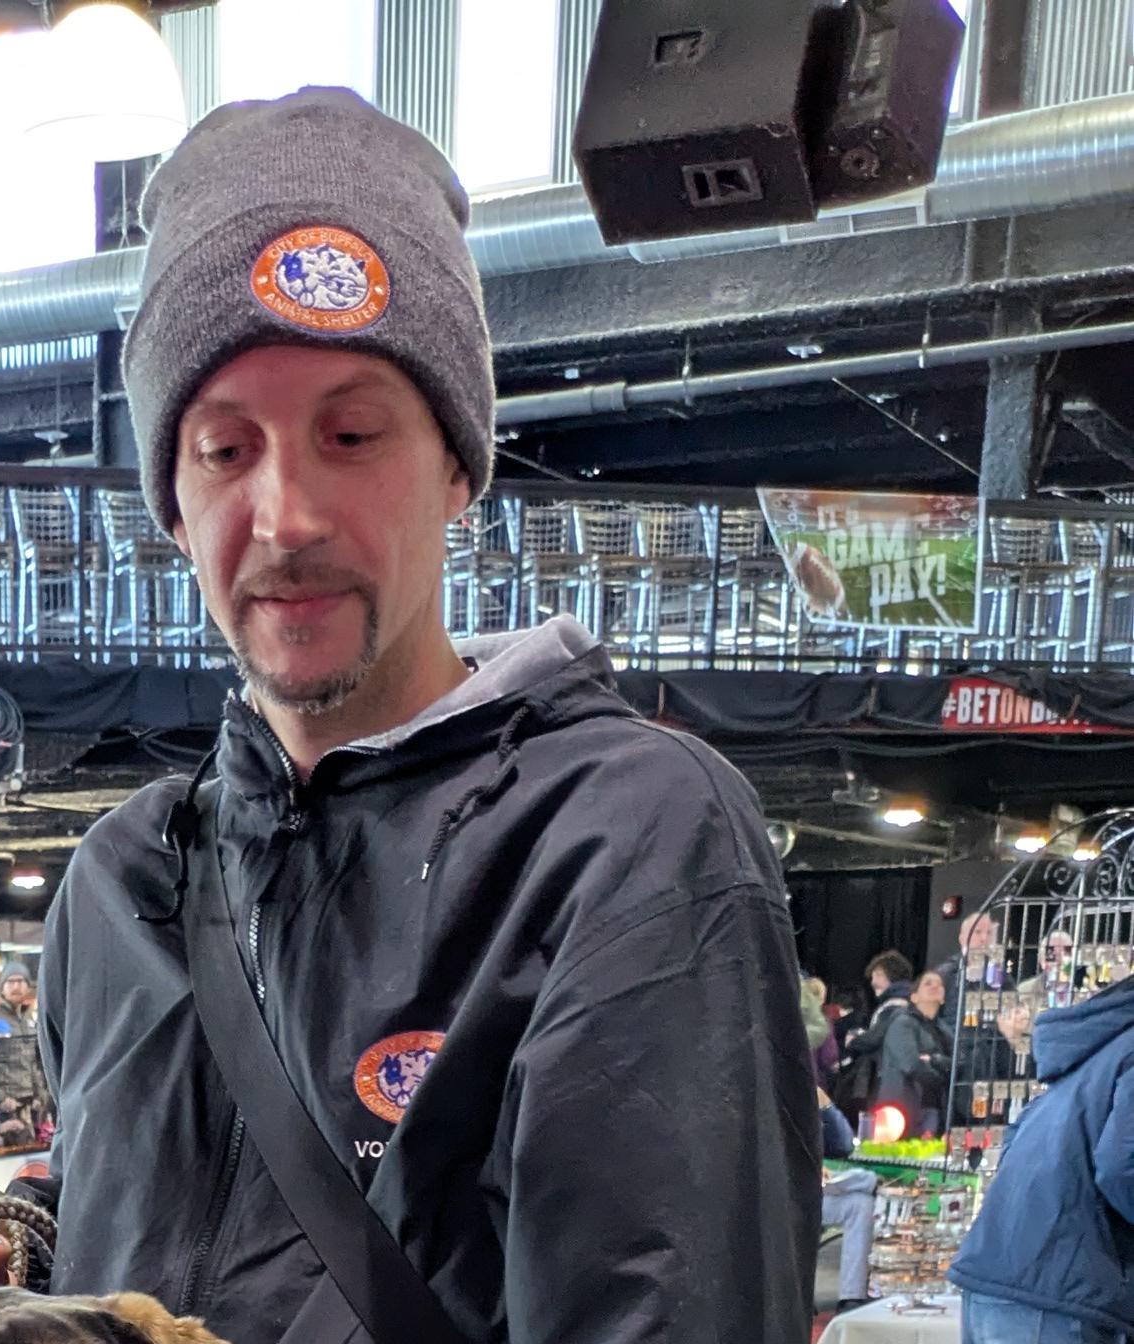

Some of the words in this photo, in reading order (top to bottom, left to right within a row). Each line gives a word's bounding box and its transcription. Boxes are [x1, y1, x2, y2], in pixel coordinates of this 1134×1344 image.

[269, 237, 295, 258] CITY
[300, 231, 317, 244] OF
[319, 230, 373, 262] BUFFALO
[264, 292, 320, 326] ANIMAL
[322, 302, 379, 327] SHELTER
[869, 554, 947, 608] DAY!
[353, 1139, 389, 1159] VO
